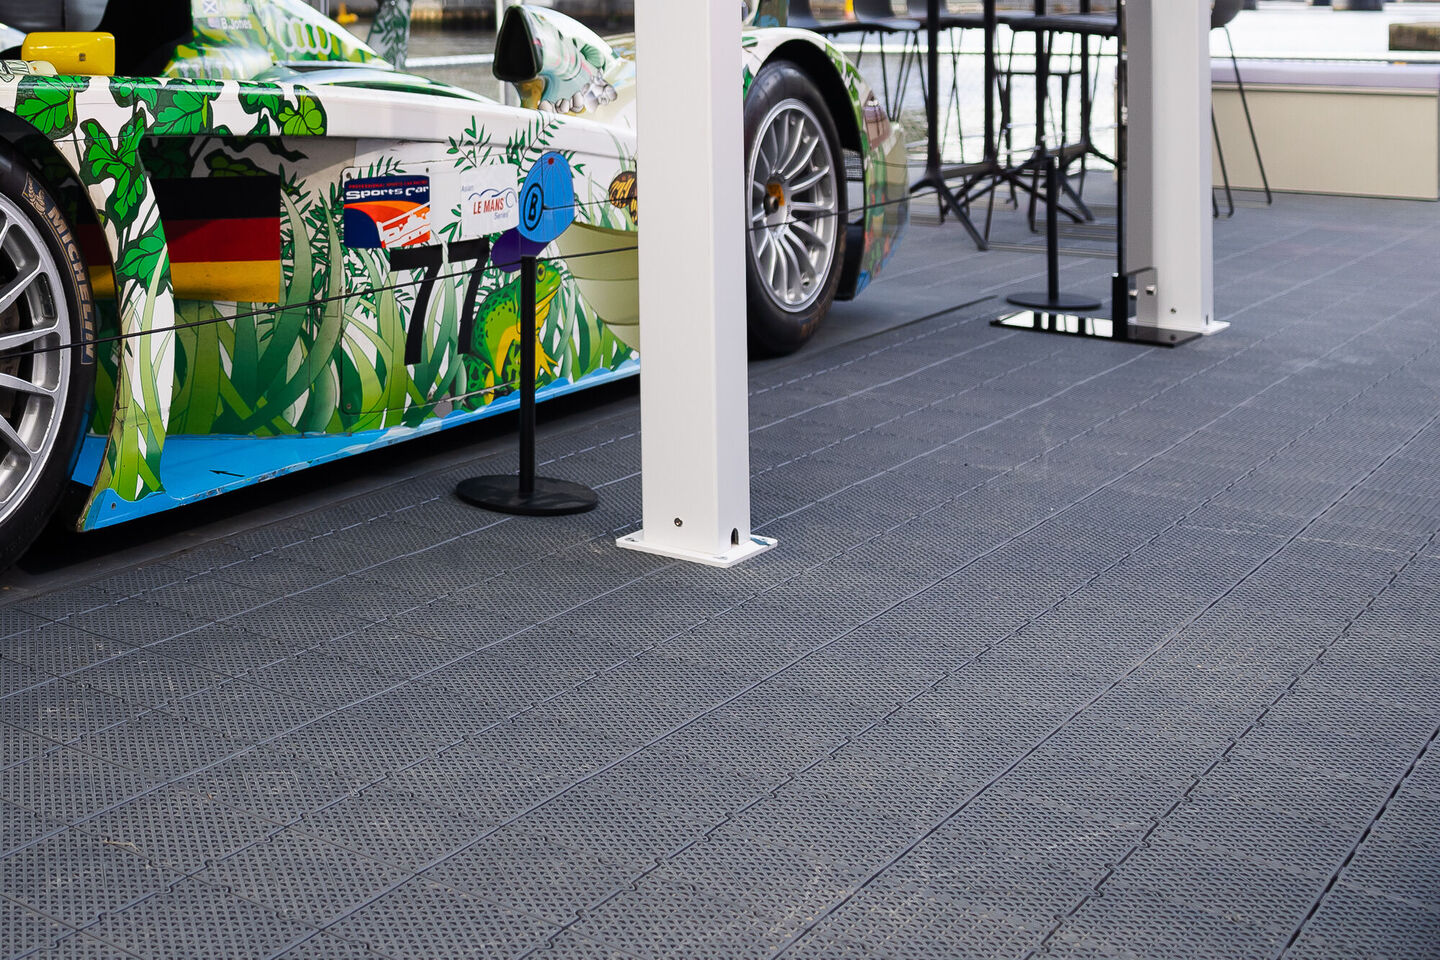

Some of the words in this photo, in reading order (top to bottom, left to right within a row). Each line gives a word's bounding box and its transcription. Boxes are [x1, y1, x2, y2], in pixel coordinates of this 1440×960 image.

[346, 188, 403, 200] Sports
[473, 201, 481, 215] LE
[483, 198, 504, 213] MANS
[47, 205, 95, 360] MICHELIN
[389, 238, 489, 366] 77
